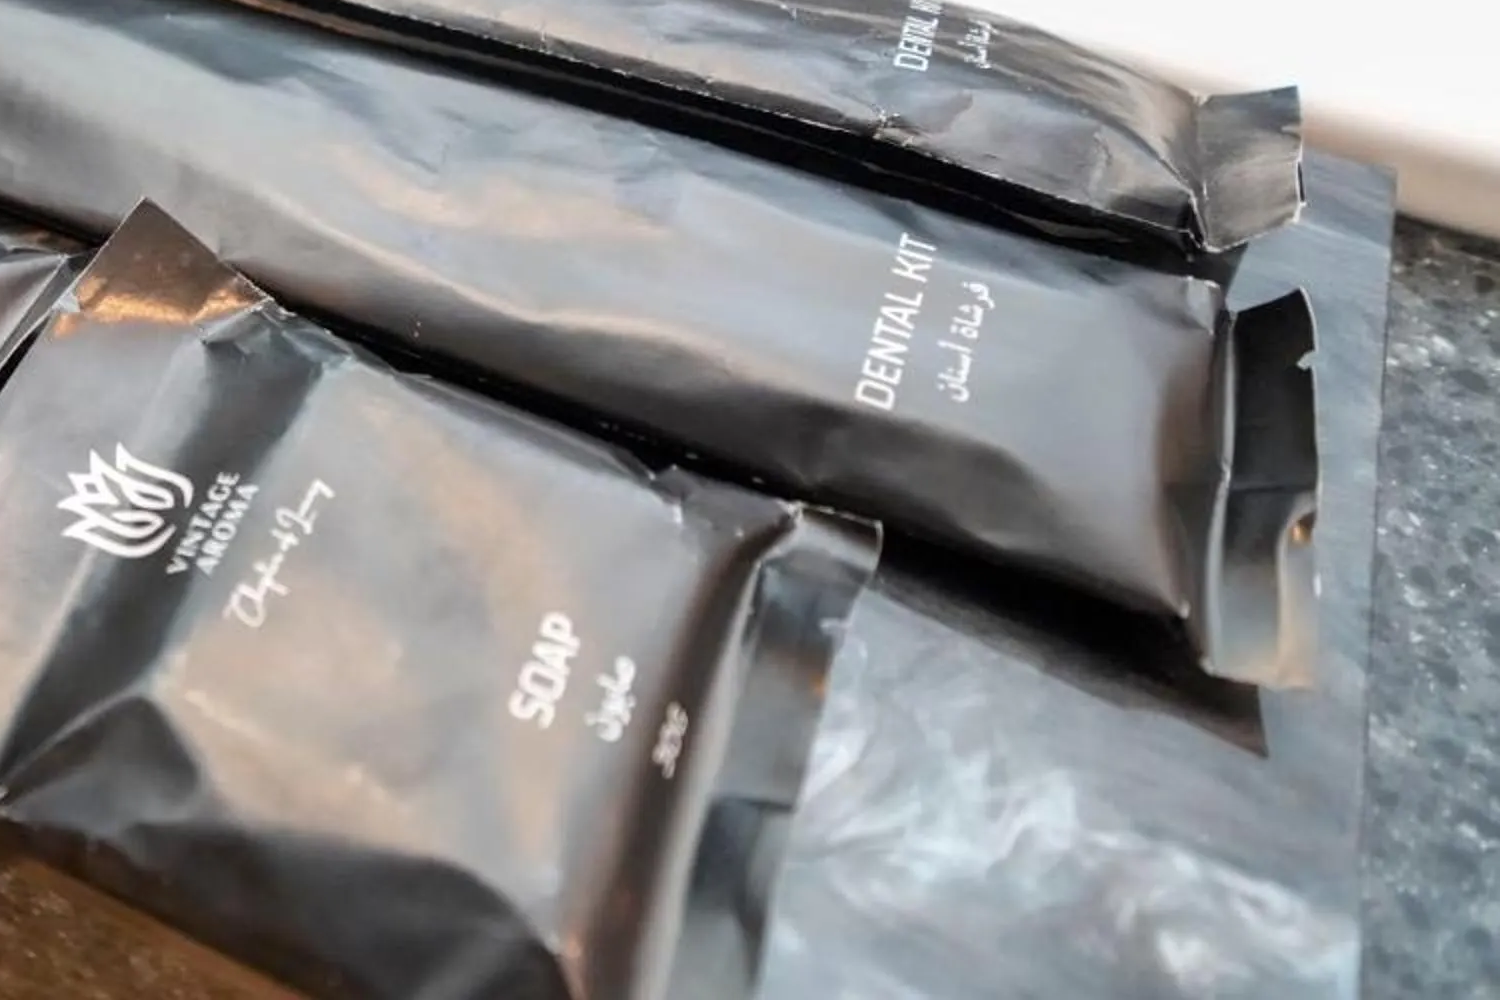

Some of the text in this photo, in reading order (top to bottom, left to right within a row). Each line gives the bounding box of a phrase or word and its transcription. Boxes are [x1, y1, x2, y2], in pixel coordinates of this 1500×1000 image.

[854, 231, 938, 412] DENTAL KIT
[165, 471, 241, 575] VINTAGE
[196, 483, 260, 578] AROMA
[508, 611, 582, 730] SOAP
